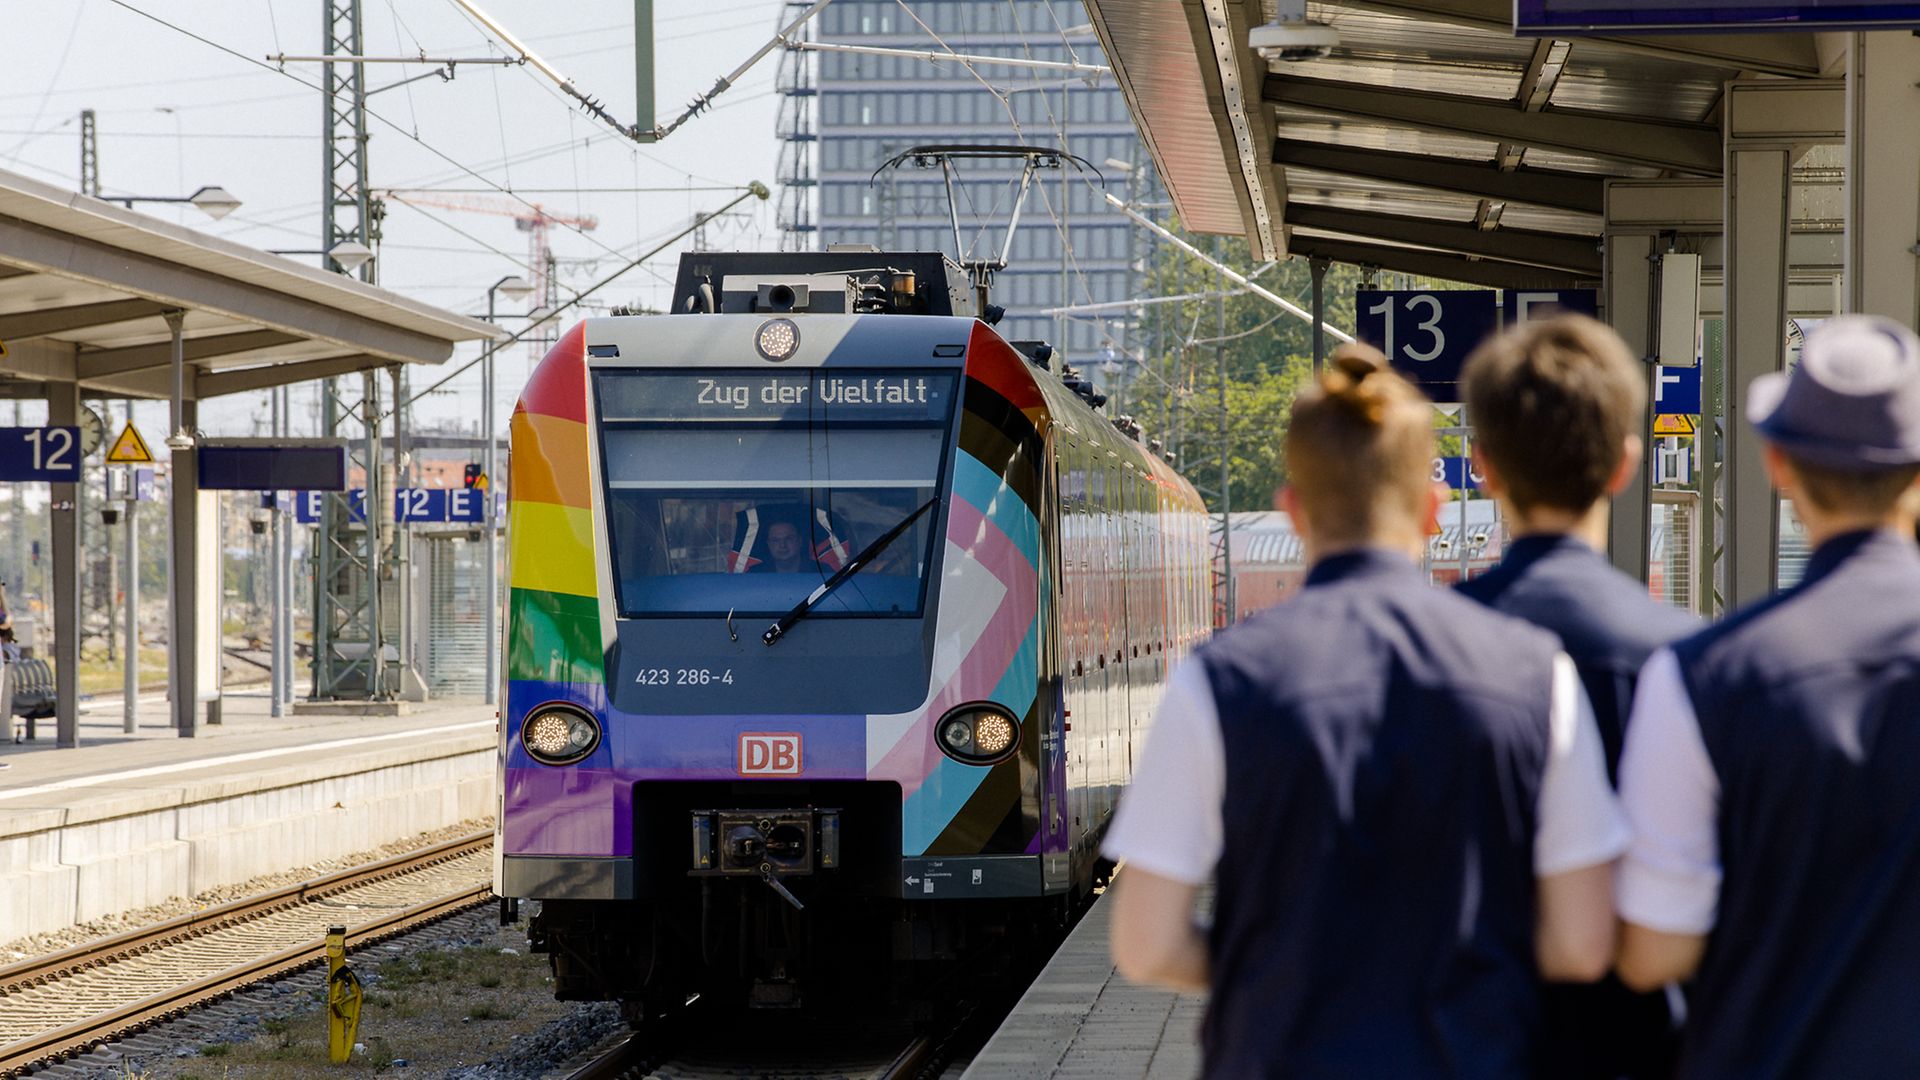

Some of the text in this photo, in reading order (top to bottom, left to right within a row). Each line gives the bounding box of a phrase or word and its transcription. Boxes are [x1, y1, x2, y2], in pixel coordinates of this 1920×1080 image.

[1369, 294, 1445, 362] 13
[697, 378, 927, 409] Zug der Vielfalt
[23, 428, 74, 471] 12
[1430, 457, 1447, 482] 3
[398, 488, 430, 516] 12
[452, 488, 471, 516] E
[635, 668, 734, 685] 423 286-4
[746, 739, 795, 770] DB
